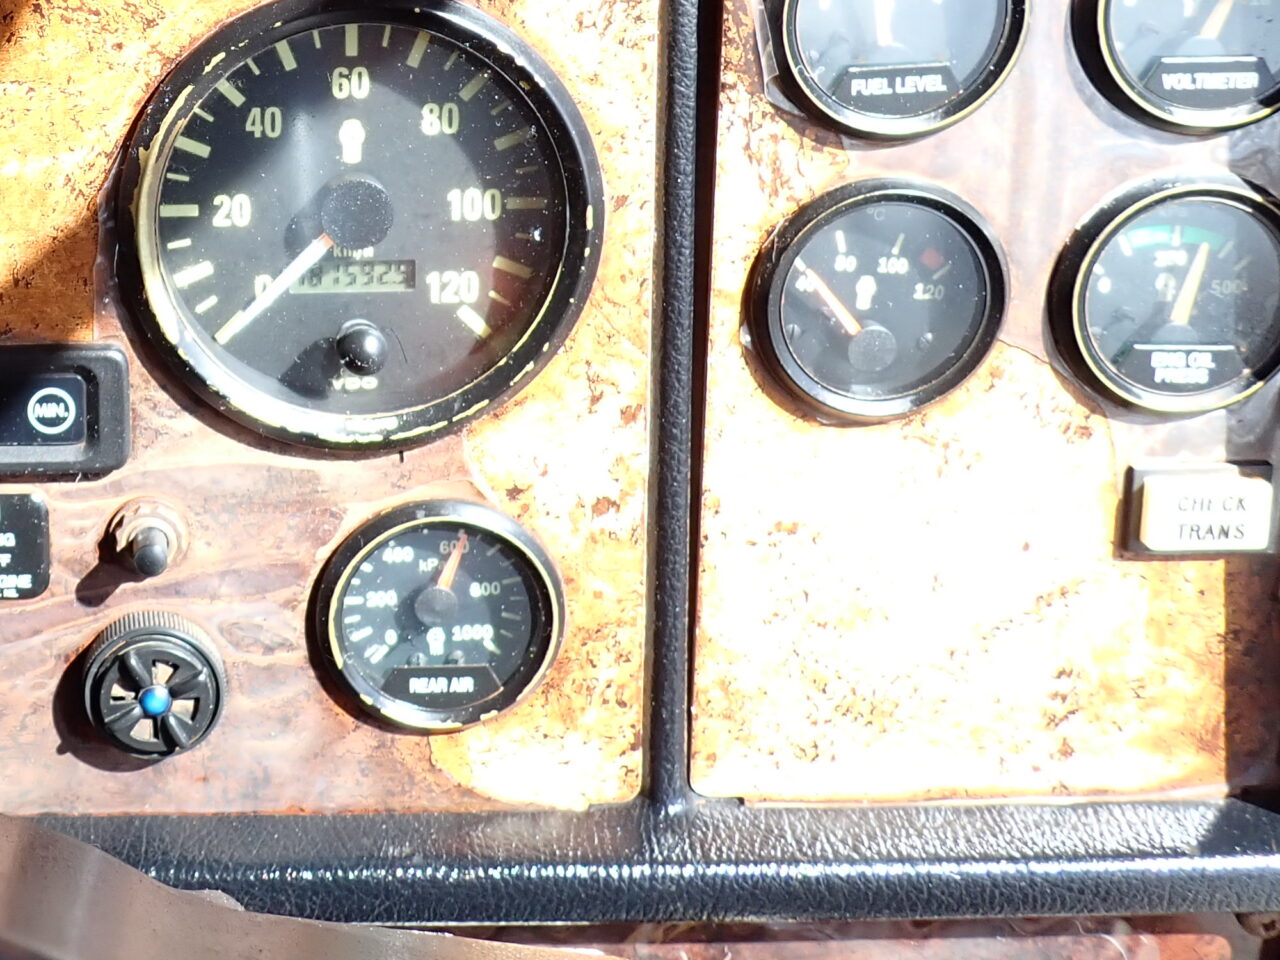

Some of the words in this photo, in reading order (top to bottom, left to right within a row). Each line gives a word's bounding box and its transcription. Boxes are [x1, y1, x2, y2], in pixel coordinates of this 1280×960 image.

[331, 66, 371, 100] 60
[851, 78, 892, 96] FUEL
[895, 75, 947, 93] LEVEL
[1162, 72, 1260, 90] VOLTMETER
[245, 106, 282, 139] 40
[420, 102, 460, 137] 80
[211, 194, 252, 228] 20
[446, 188, 503, 222] 100
[834, 254, 857, 272] 80
[877, 256, 909, 275] 100
[425, 270, 479, 304] 120
[913, 283, 945, 300] 120
[330, 376, 378, 391] VDO
[33, 403, 69, 419] MIN.
[1178, 497, 1246, 512] CHECK
[1179, 524, 1245, 540] TRANS
[382, 546, 414, 563] 400
[439, 540, 470, 555] 600
[470, 581, 501, 598] 800
[384, 629, 398, 645] 0
[451, 624, 494, 641] 1000
[409, 677, 447, 694] REAR
[449, 677, 474, 693] AIR
